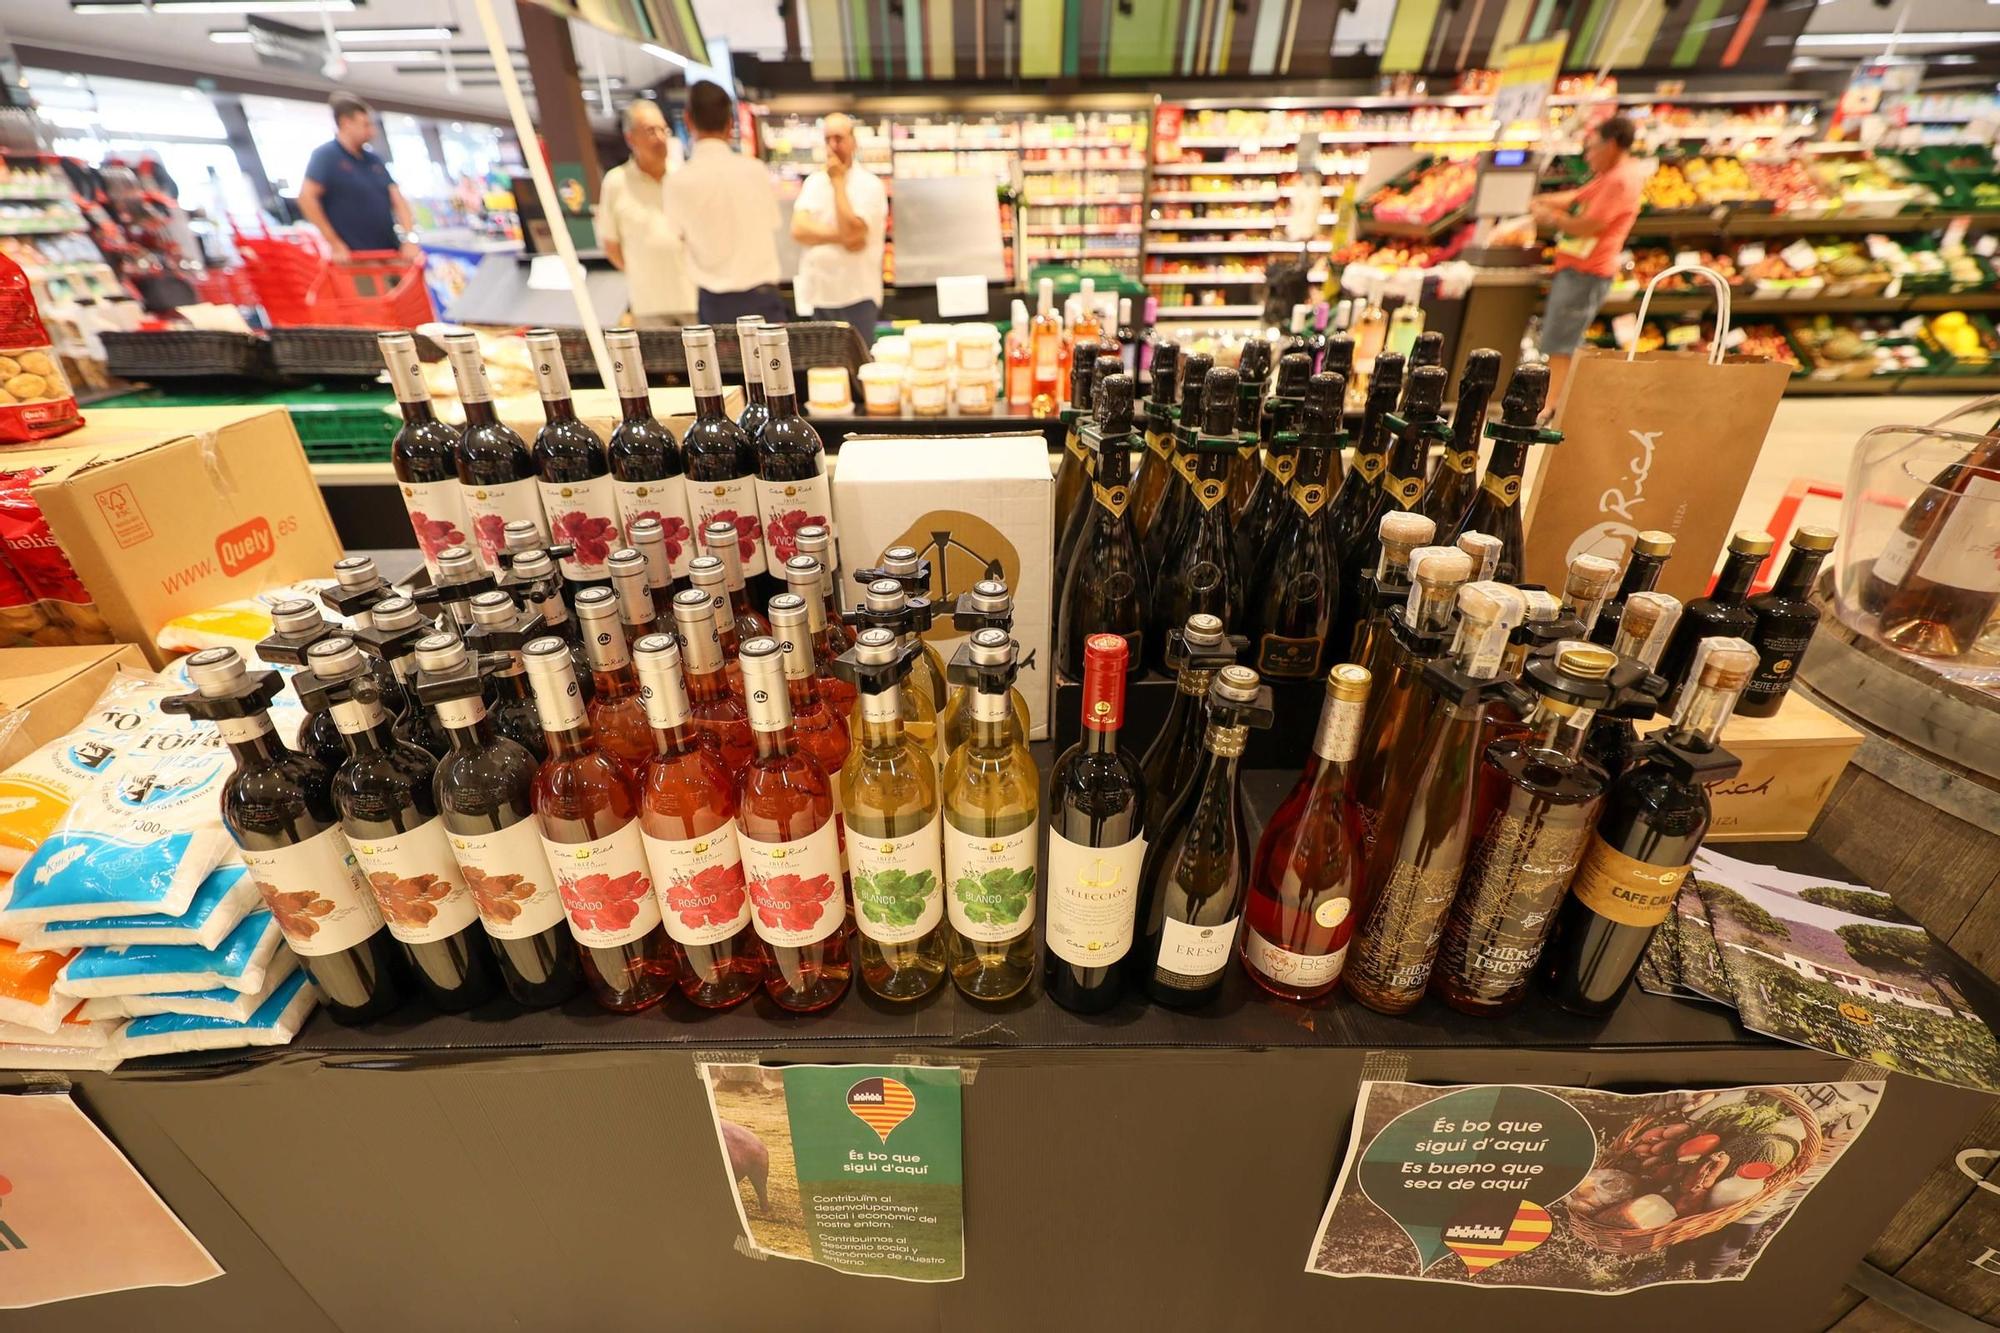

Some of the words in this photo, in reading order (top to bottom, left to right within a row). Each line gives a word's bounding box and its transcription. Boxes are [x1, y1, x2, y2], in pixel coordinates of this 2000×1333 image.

[1599, 430, 1664, 520] Rich
[711, 834, 729, 847] Rich
[896, 841, 915, 851] Rich
[1005, 840, 1024, 849] Rich
[376, 844, 399, 854] Rich
[592, 844, 614, 855] Rich
[788, 845, 809, 856] Rich
[255, 858, 277, 866] Rich
[678, 894, 718, 908] ROSADO
[861, 890, 896, 905] BLANCO
[965, 891, 1002, 904] BLANCO
[1611, 886, 1649, 905] CAFE
[567, 899, 604, 911] ROSADO
[756, 895, 791, 910] ROSADO
[1874, 1014, 1919, 1035] Rich
[1433, 1116, 1456, 1133] És
[1461, 1120, 1491, 1132] bo
[1498, 1121, 1543, 1134] que
[1415, 1138, 1467, 1155] sigui
[849, 1149, 864, 1161] És
[868, 1151, 888, 1161] bo
[892, 1153, 921, 1164] que
[843, 1162, 877, 1173] sigui
[881, 1163, 929, 1175] d'aquí
[1401, 1161, 1423, 1174] Es
[1428, 1162, 1496, 1174] bueno
[1501, 1162, 1544, 1175] que
[1403, 1179, 1443, 1190] sea
[1448, 1178, 1476, 1190] de
[1481, 1177, 1532, 1192] aquí
[880, 1195, 892, 1203] al
[814, 1203, 919, 1214] desenvolupament
[815, 1212, 849, 1220] social
[918, 1216, 937, 1224] del
[854, 1221, 894, 1229] entorn.
[819, 1233, 893, 1243] Contribuimos
[896, 1236, 907, 1244] al
[820, 1241, 874, 1251] desarrollo
[876, 1243, 909, 1253] social
[912, 1247, 919, 1255] y
[821, 1248, 885, 1259] económico
[887, 1252, 902, 1260] de
[904, 1254, 946, 1264] nuestro
[823, 1255, 868, 1266] entorno.
